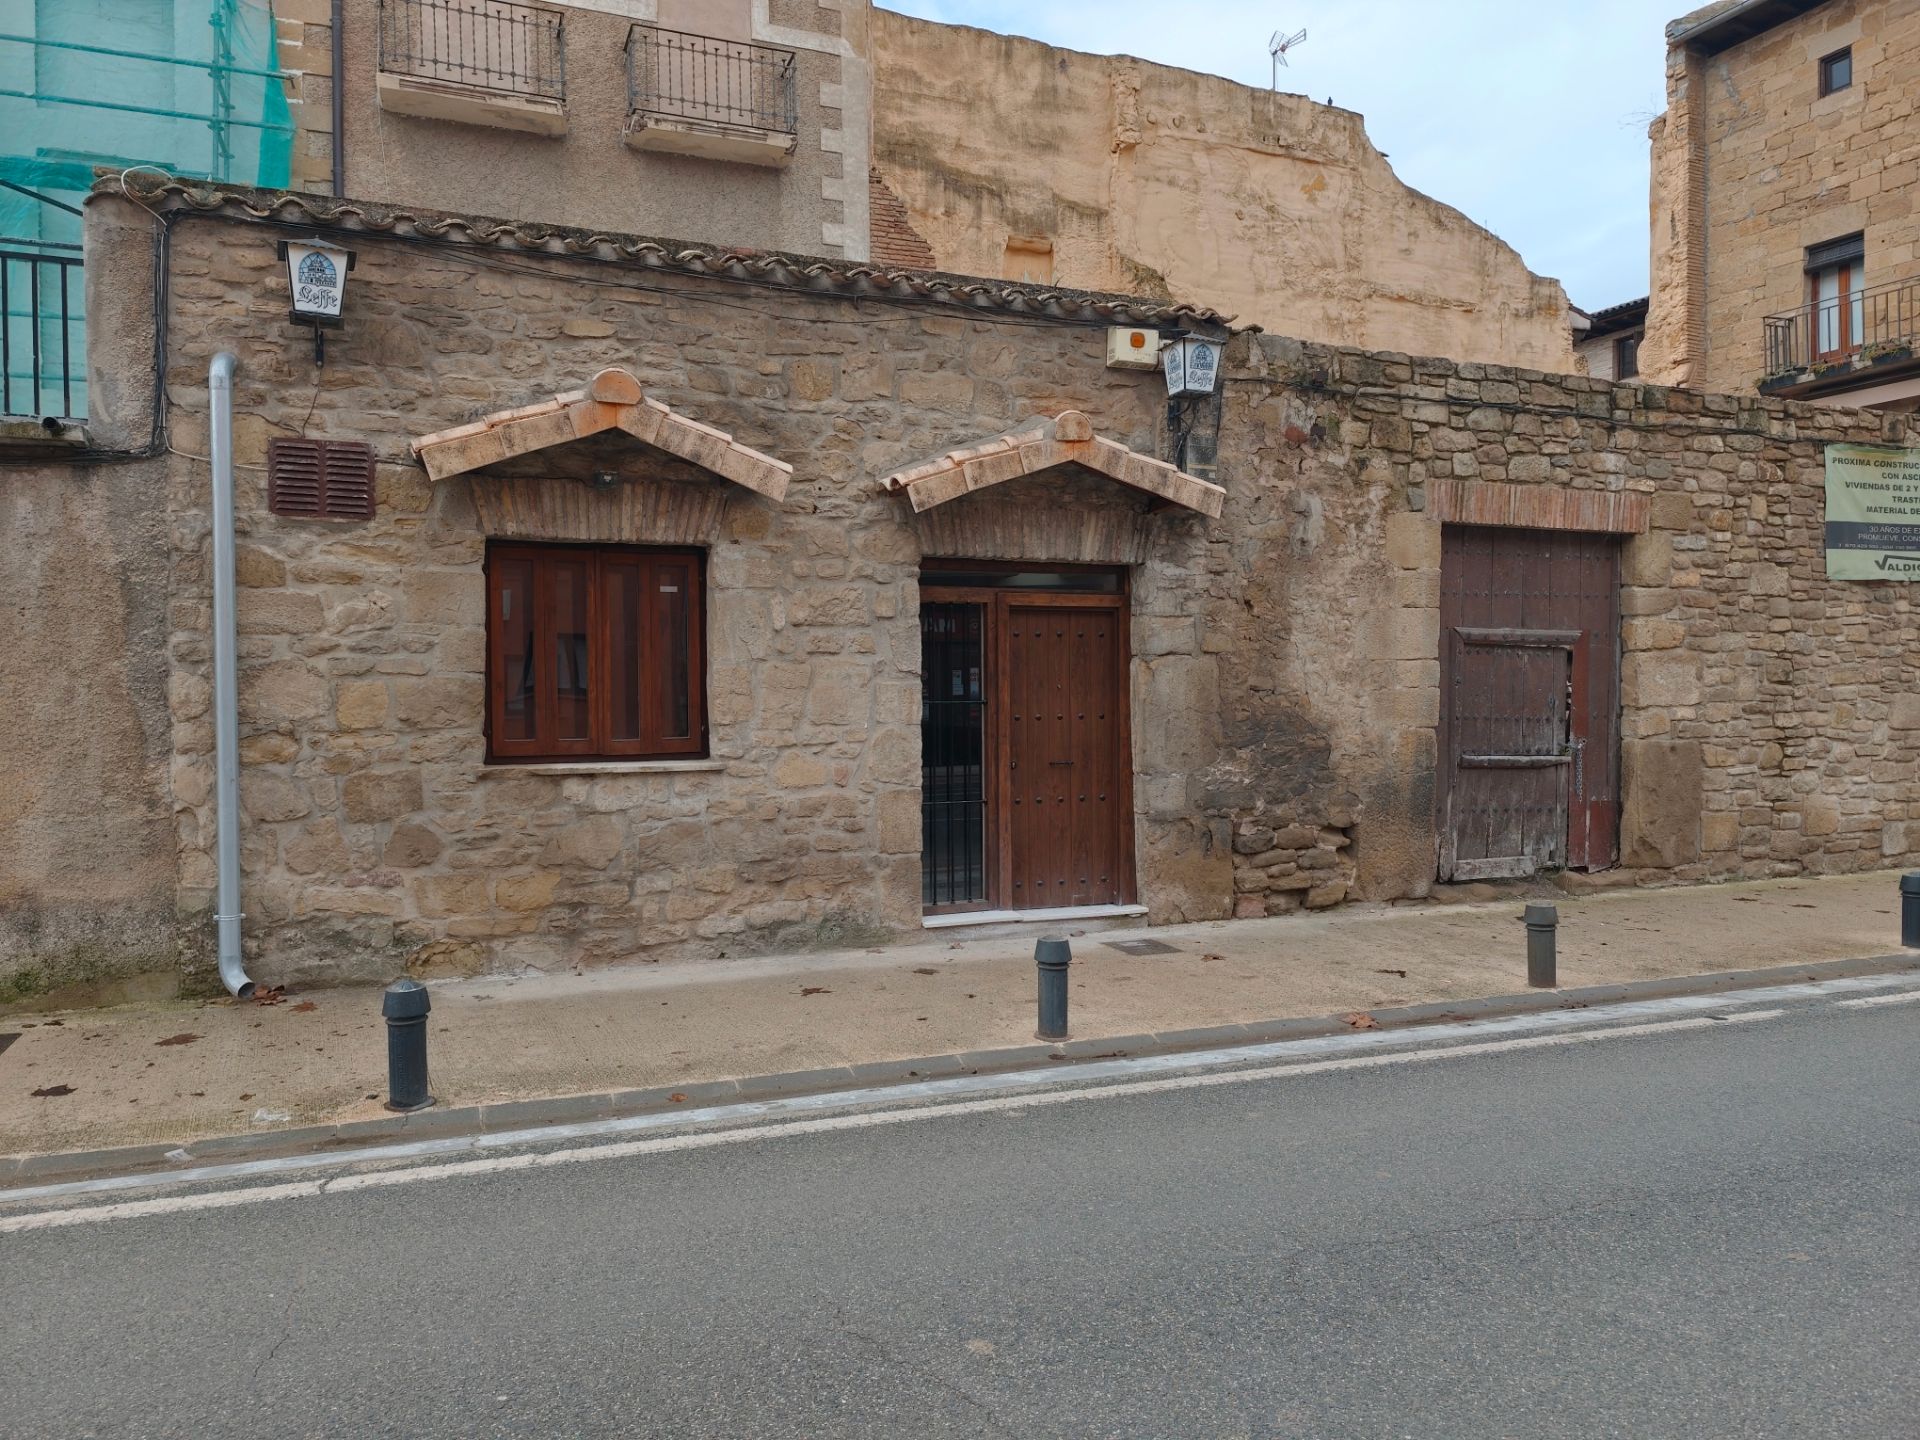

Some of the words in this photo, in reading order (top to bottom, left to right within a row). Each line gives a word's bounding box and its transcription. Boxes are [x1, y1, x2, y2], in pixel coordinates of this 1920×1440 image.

[296, 285, 338, 309] Leffe
[1832, 457, 1871, 467] PROXIMA
[1882, 472, 1900, 480] CON
[1902, 473, 1920, 481] ASC
[1845, 481, 1890, 491] VIVIENDAS
[1893, 484, 1904, 492] DE
[1914, 485, 1919, 493] Y
[1892, 496, 1920, 504] TRAST
[1866, 506, 1908, 515] MATERIAL
[1880, 525, 1900, 534] AÑOS
